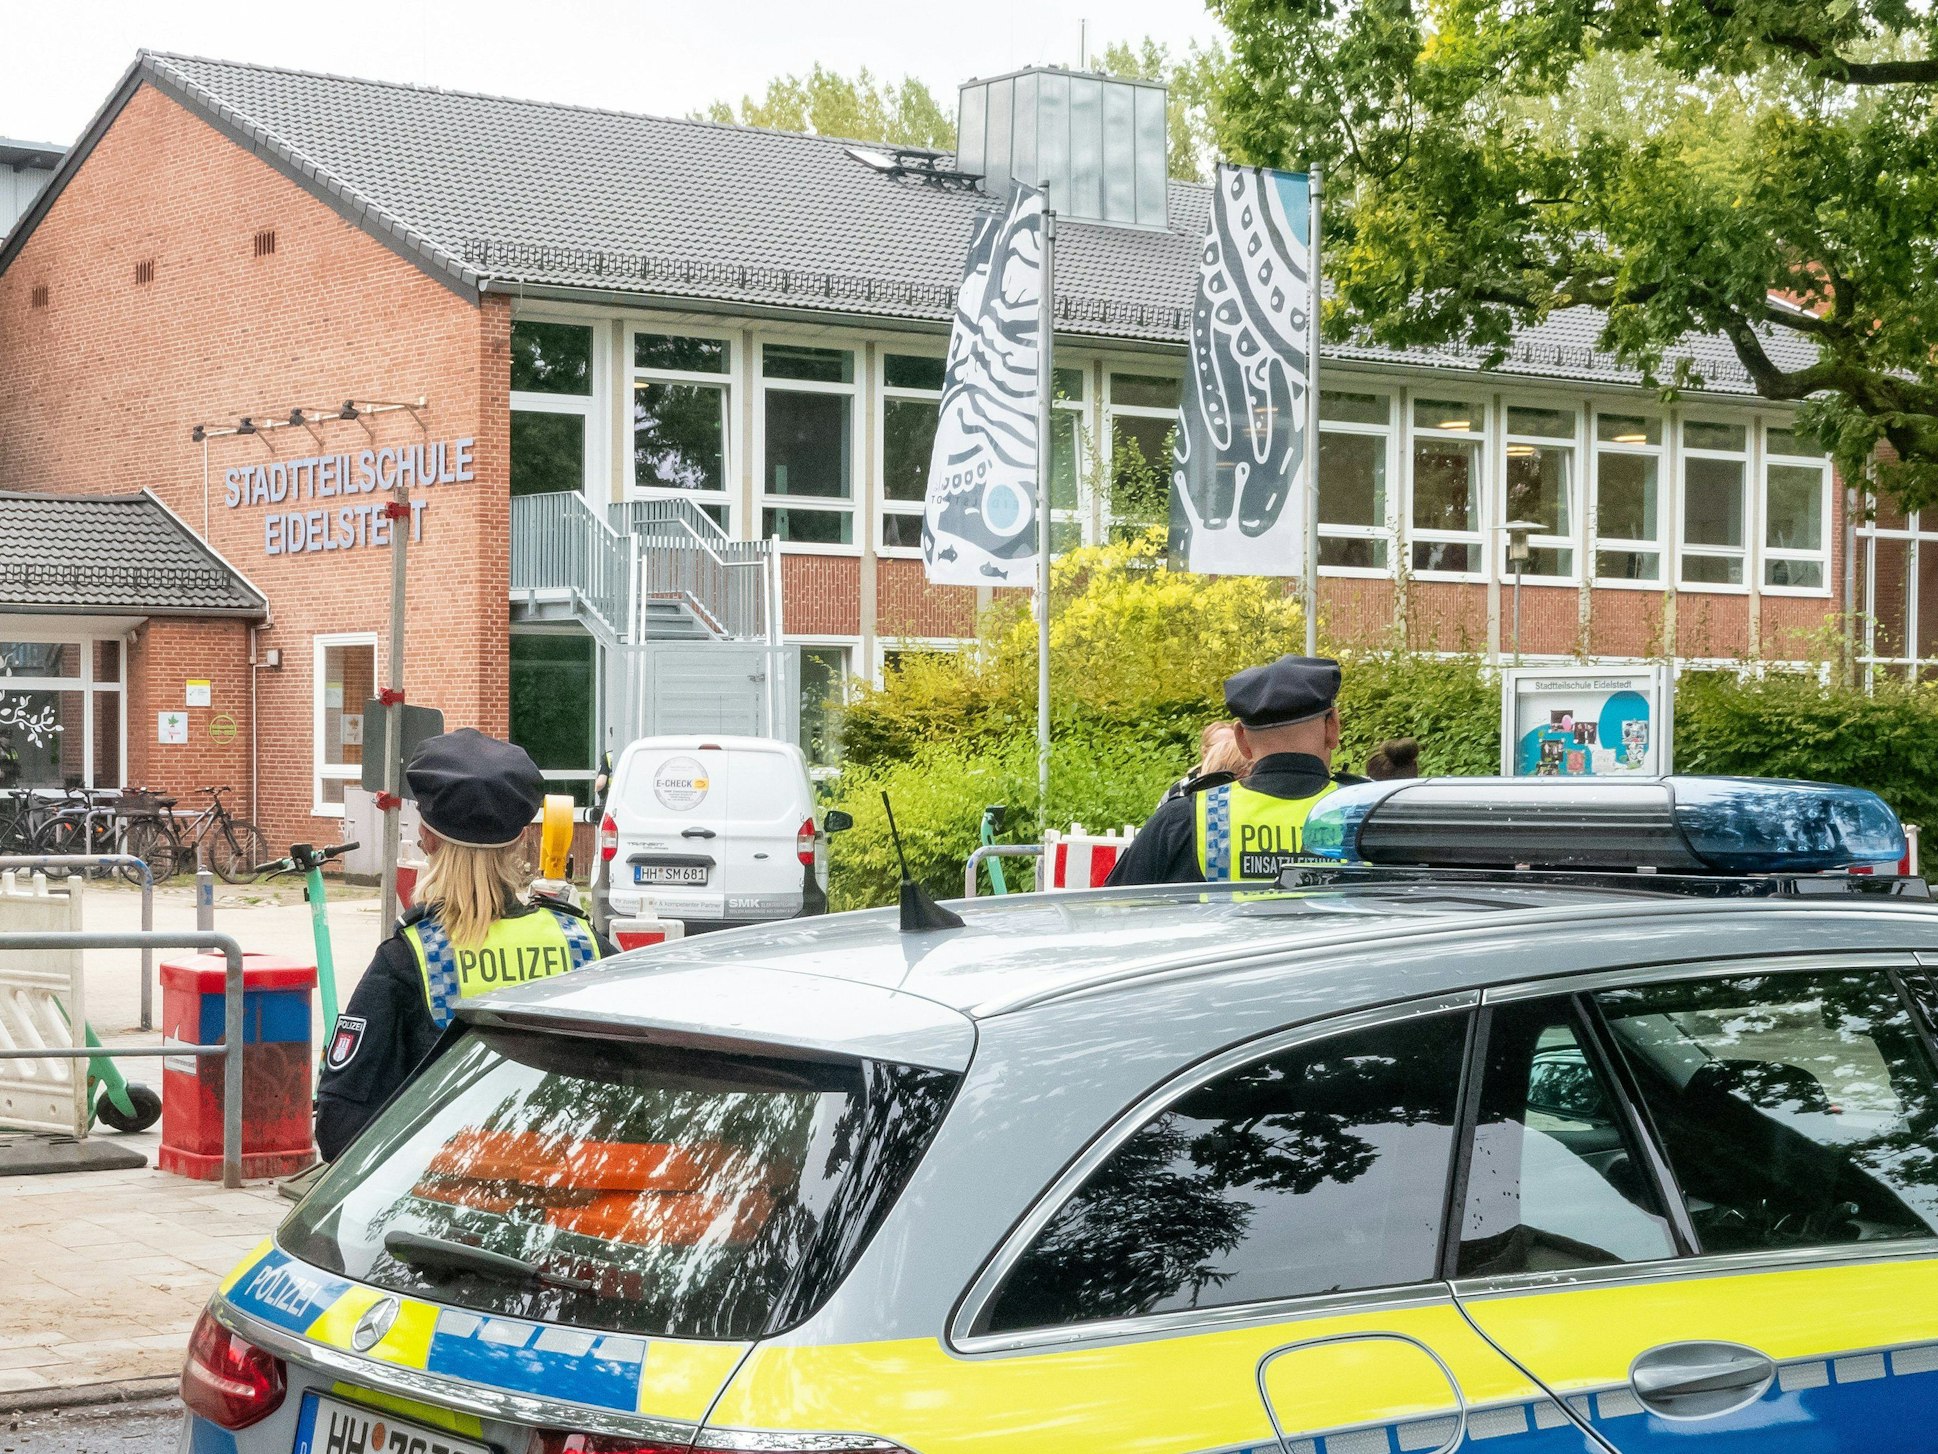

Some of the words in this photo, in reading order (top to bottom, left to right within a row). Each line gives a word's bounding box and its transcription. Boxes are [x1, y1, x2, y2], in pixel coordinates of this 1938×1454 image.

[224, 437, 475, 508] STADTTEILSCHULE
[265, 499, 428, 555] EIDELSTET
[1535, 680, 1592, 690] Stadtteilschule
[1593, 680, 1632, 689] Eidelstedt
[656, 779, 692, 788] E-CHECK
[1241, 825, 1303, 853] POLI
[642, 868, 657, 879] HH
[665, 868, 681, 880] SM
[683, 868, 705, 880] 681
[728, 898, 760, 908] SMK
[459, 946, 569, 983] POLIZEI
[338, 1020, 364, 1031] POLIZEI
[243, 1265, 323, 1317] POLIZEI
